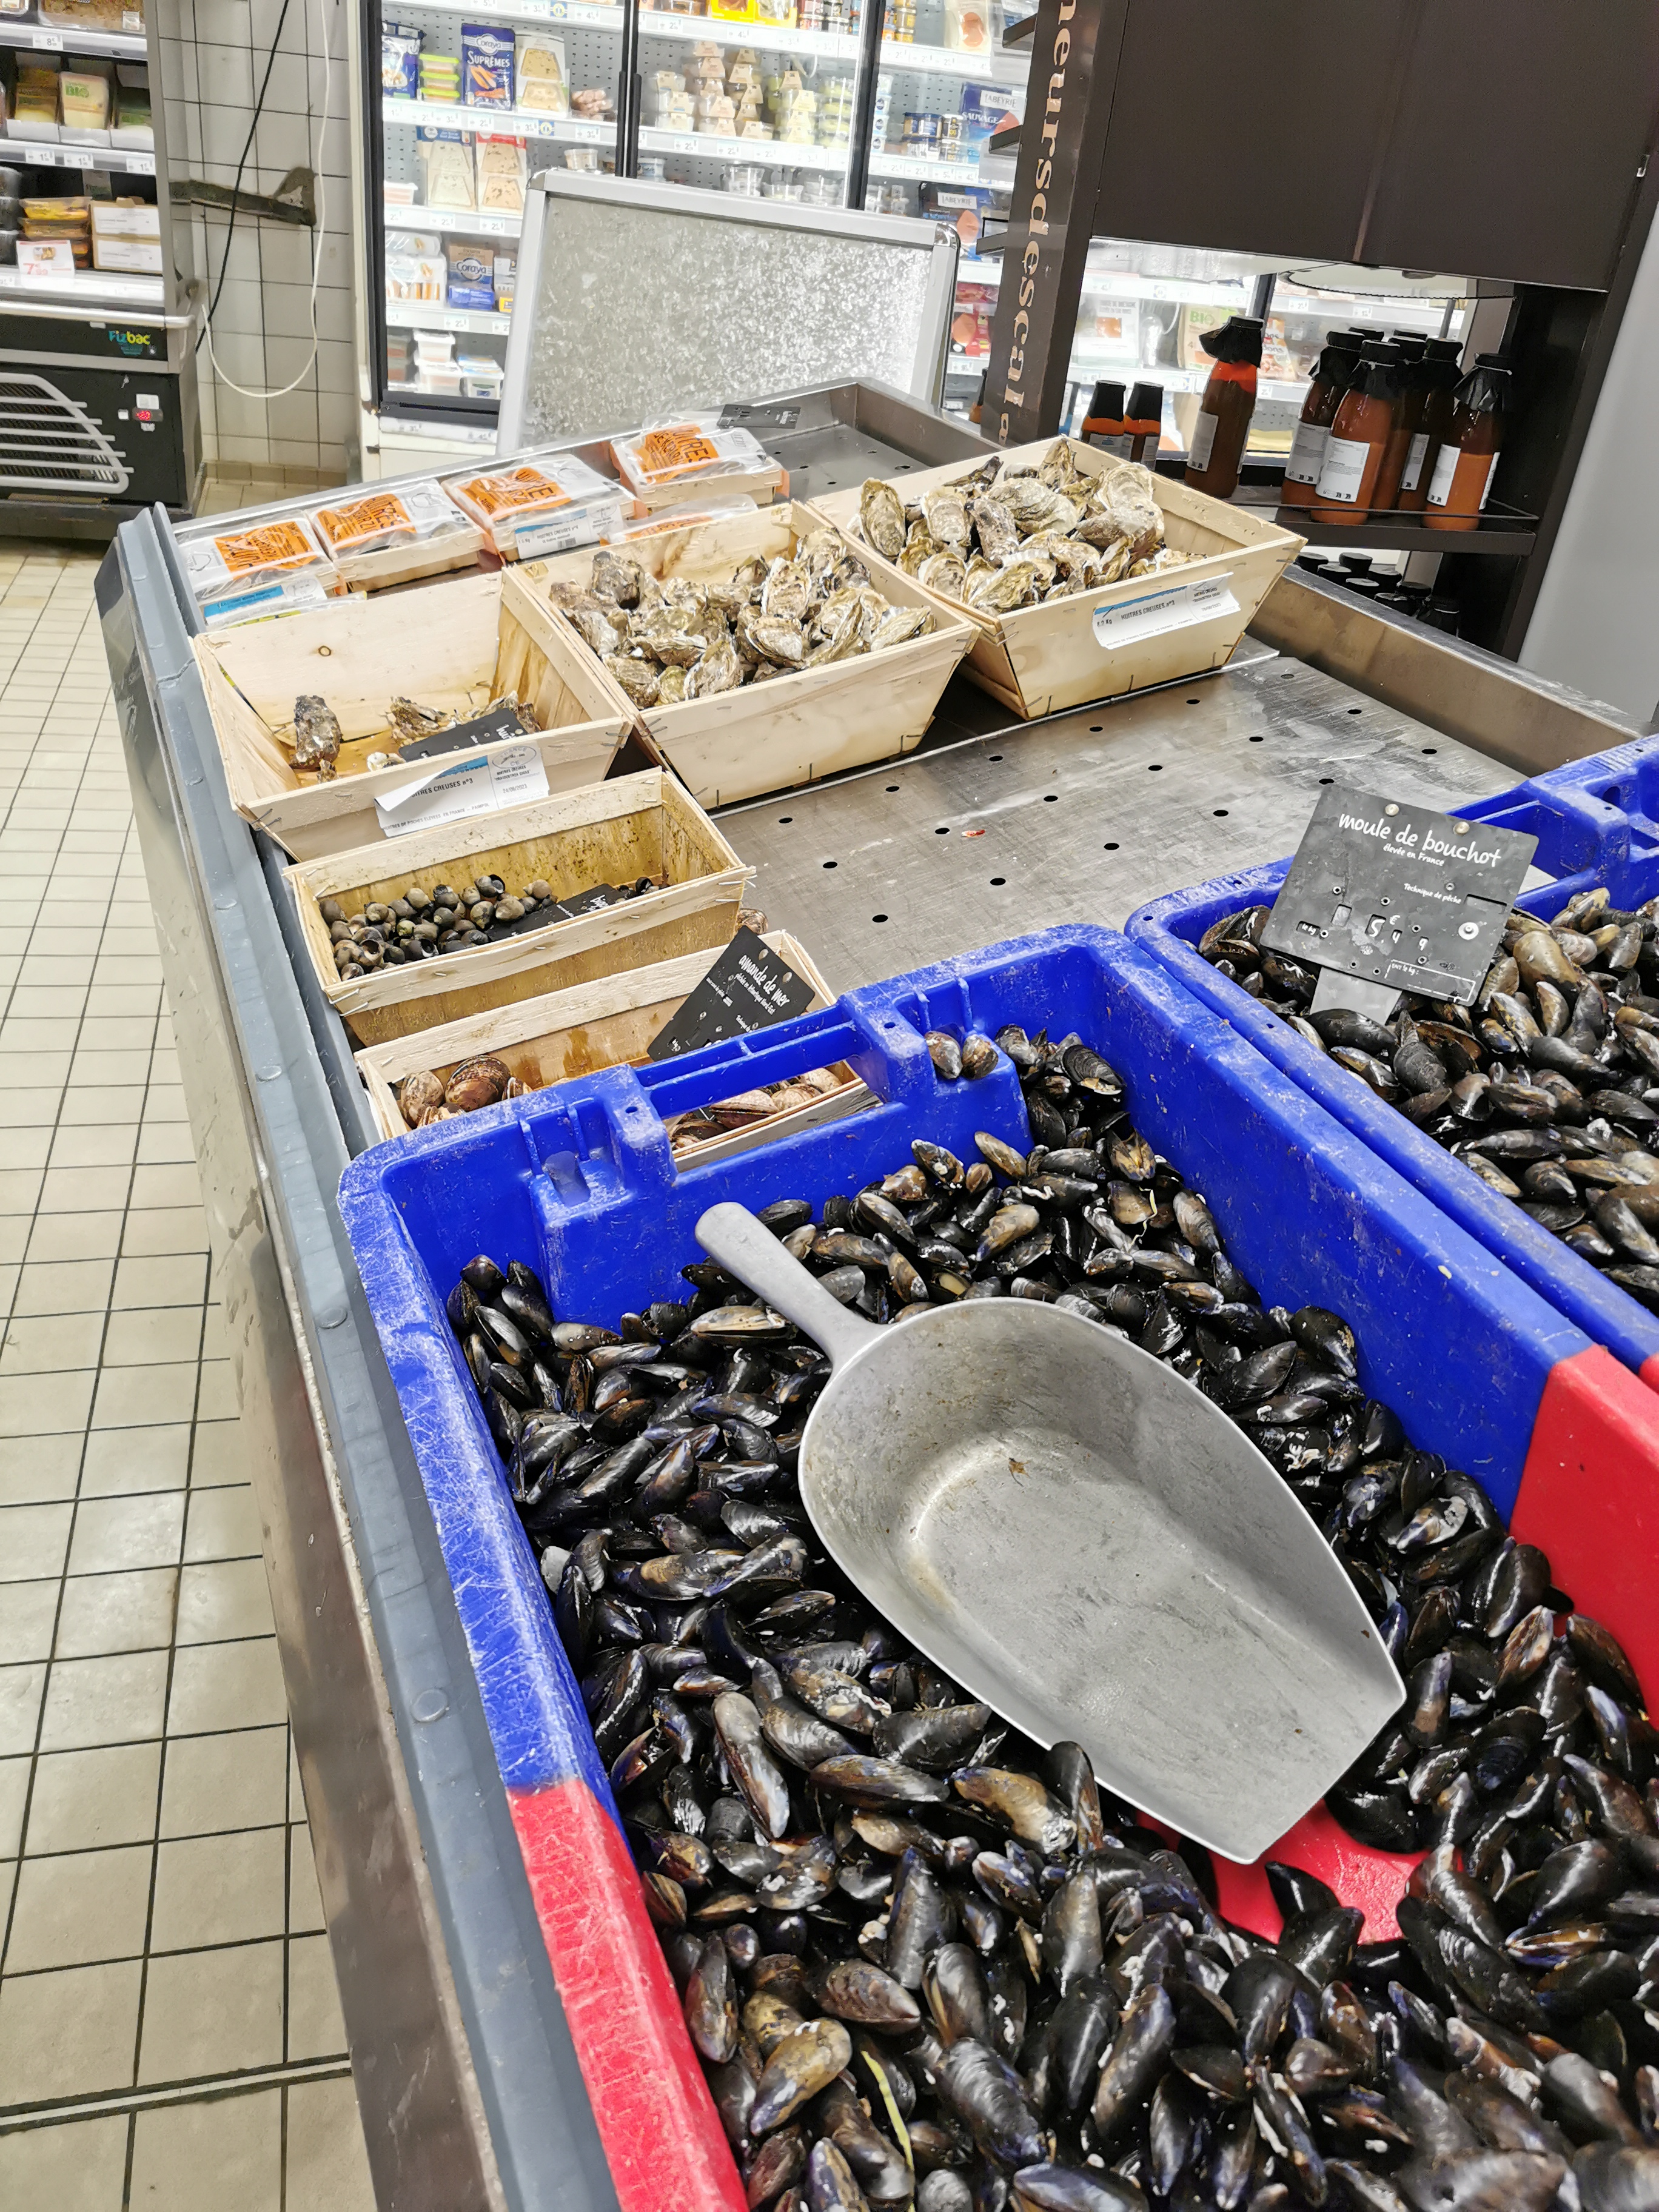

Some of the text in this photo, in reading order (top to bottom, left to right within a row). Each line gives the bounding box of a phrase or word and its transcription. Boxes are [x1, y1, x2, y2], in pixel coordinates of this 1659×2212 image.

[476, 38, 501, 49] Coraya
[984, 93, 1016, 108] LABEYRIE
[962, 112, 999, 124] SAUVAGE
[456, 261, 487, 275] Coraya
[1190, 310, 1215, 326] BIO
[1121, 610, 1142, 620] HUITRES
[1143, 603, 1165, 614] CREUSES
[410, 787, 432, 799] UITRES
[434, 780, 461, 793] CREUSES
[1339, 813, 1502, 867] moule de bouchot
[1383, 843, 1405, 856] élevée
[1418, 851, 1445, 866] France
[1404, 883, 1462, 905] Technique de pêche
[739, 954, 790, 1007] amande de mer
